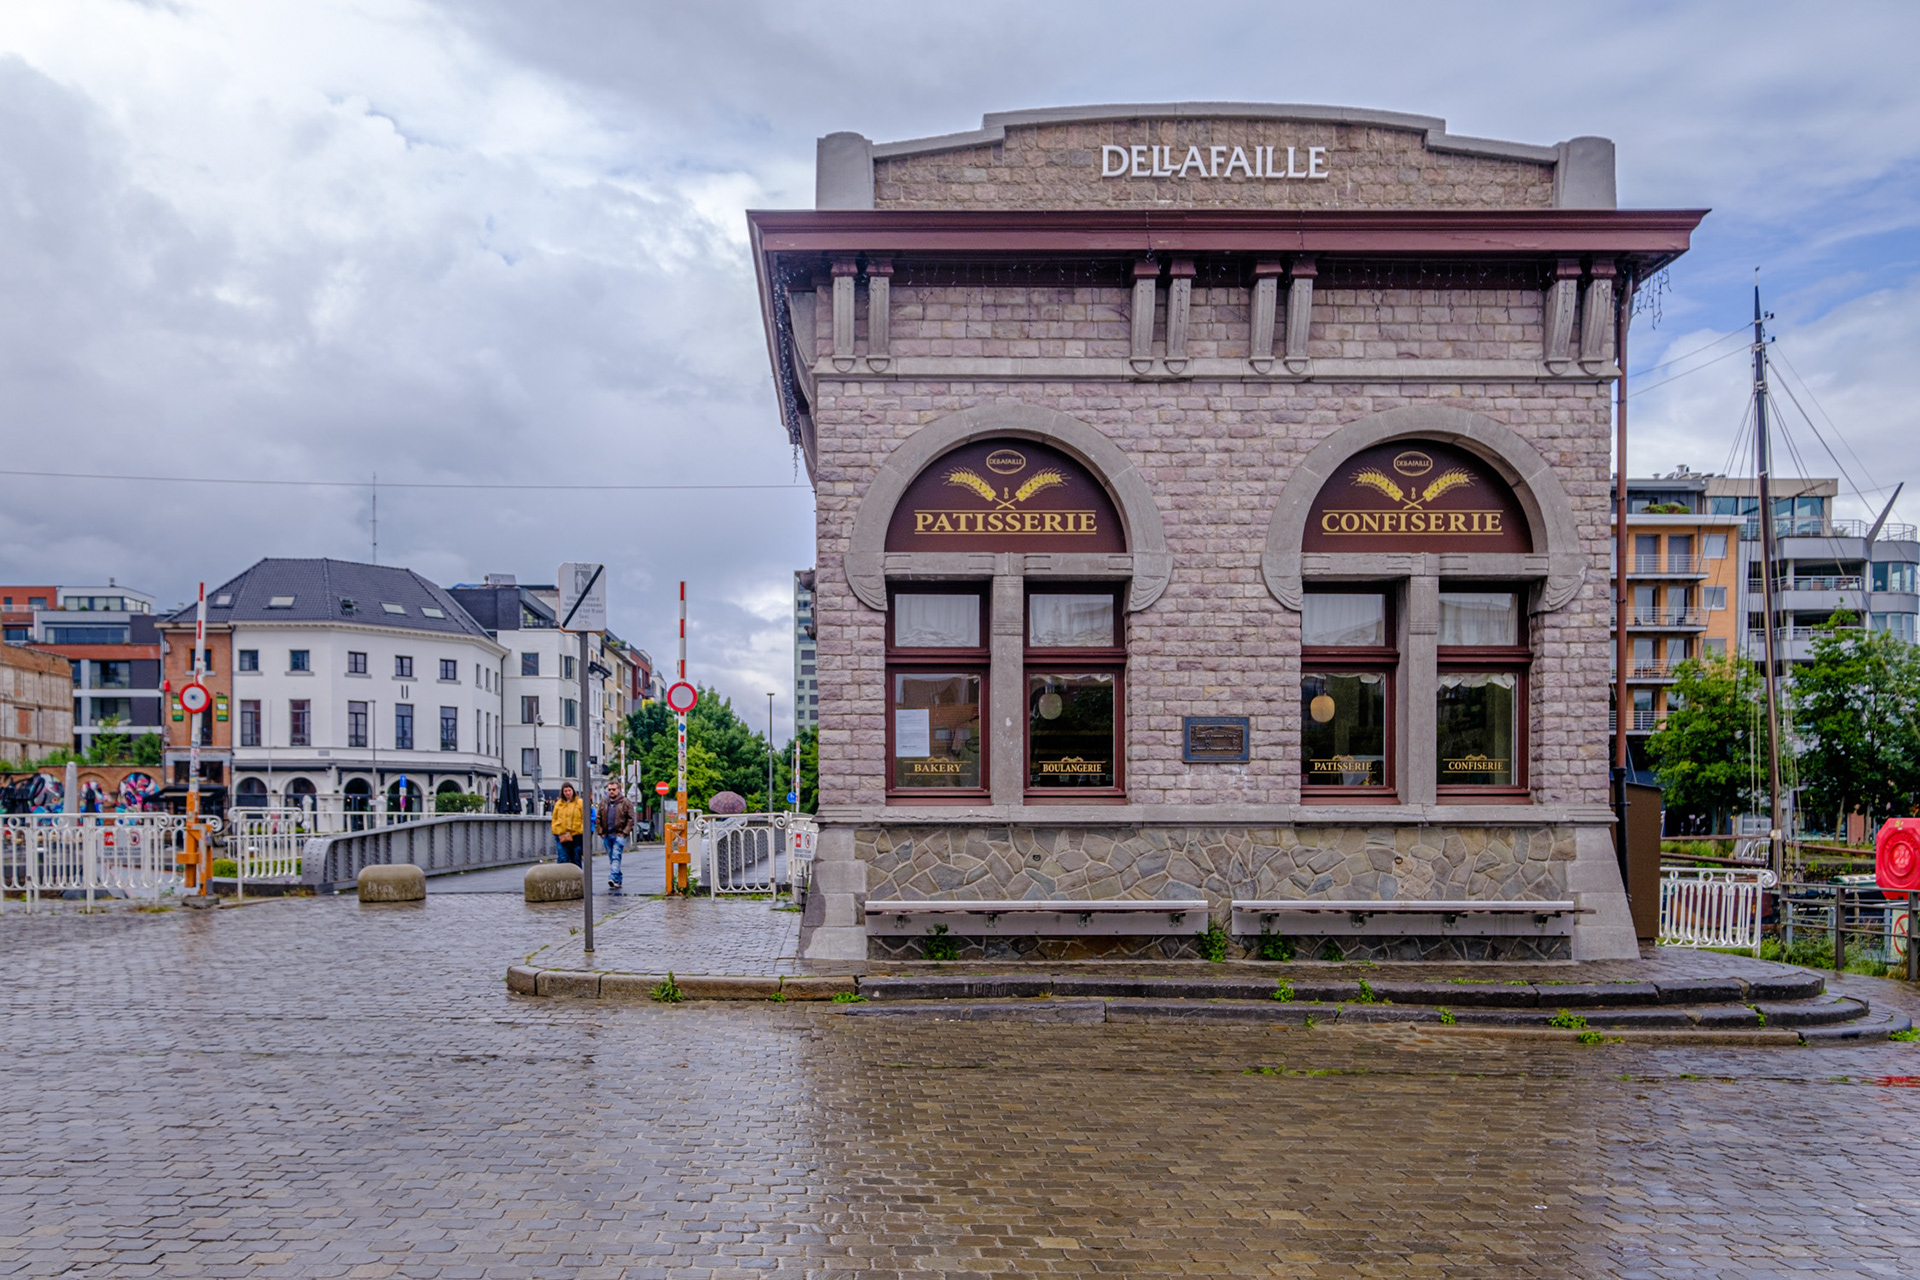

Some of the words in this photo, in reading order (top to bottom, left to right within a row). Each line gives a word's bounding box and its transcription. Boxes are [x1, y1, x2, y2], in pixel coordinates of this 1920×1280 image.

[1101, 145, 1329, 178] DELLAFAILLE
[914, 512, 1098, 532] PATISSERIE
[1321, 512, 1503, 532] CONFISERIE
[914, 763, 962, 773] BAKERY
[1042, 763, 1102, 773] BOULANGERIE
[1314, 761, 1373, 771] PATISSERIE
[1448, 761, 1504, 771] CONFISERIE
